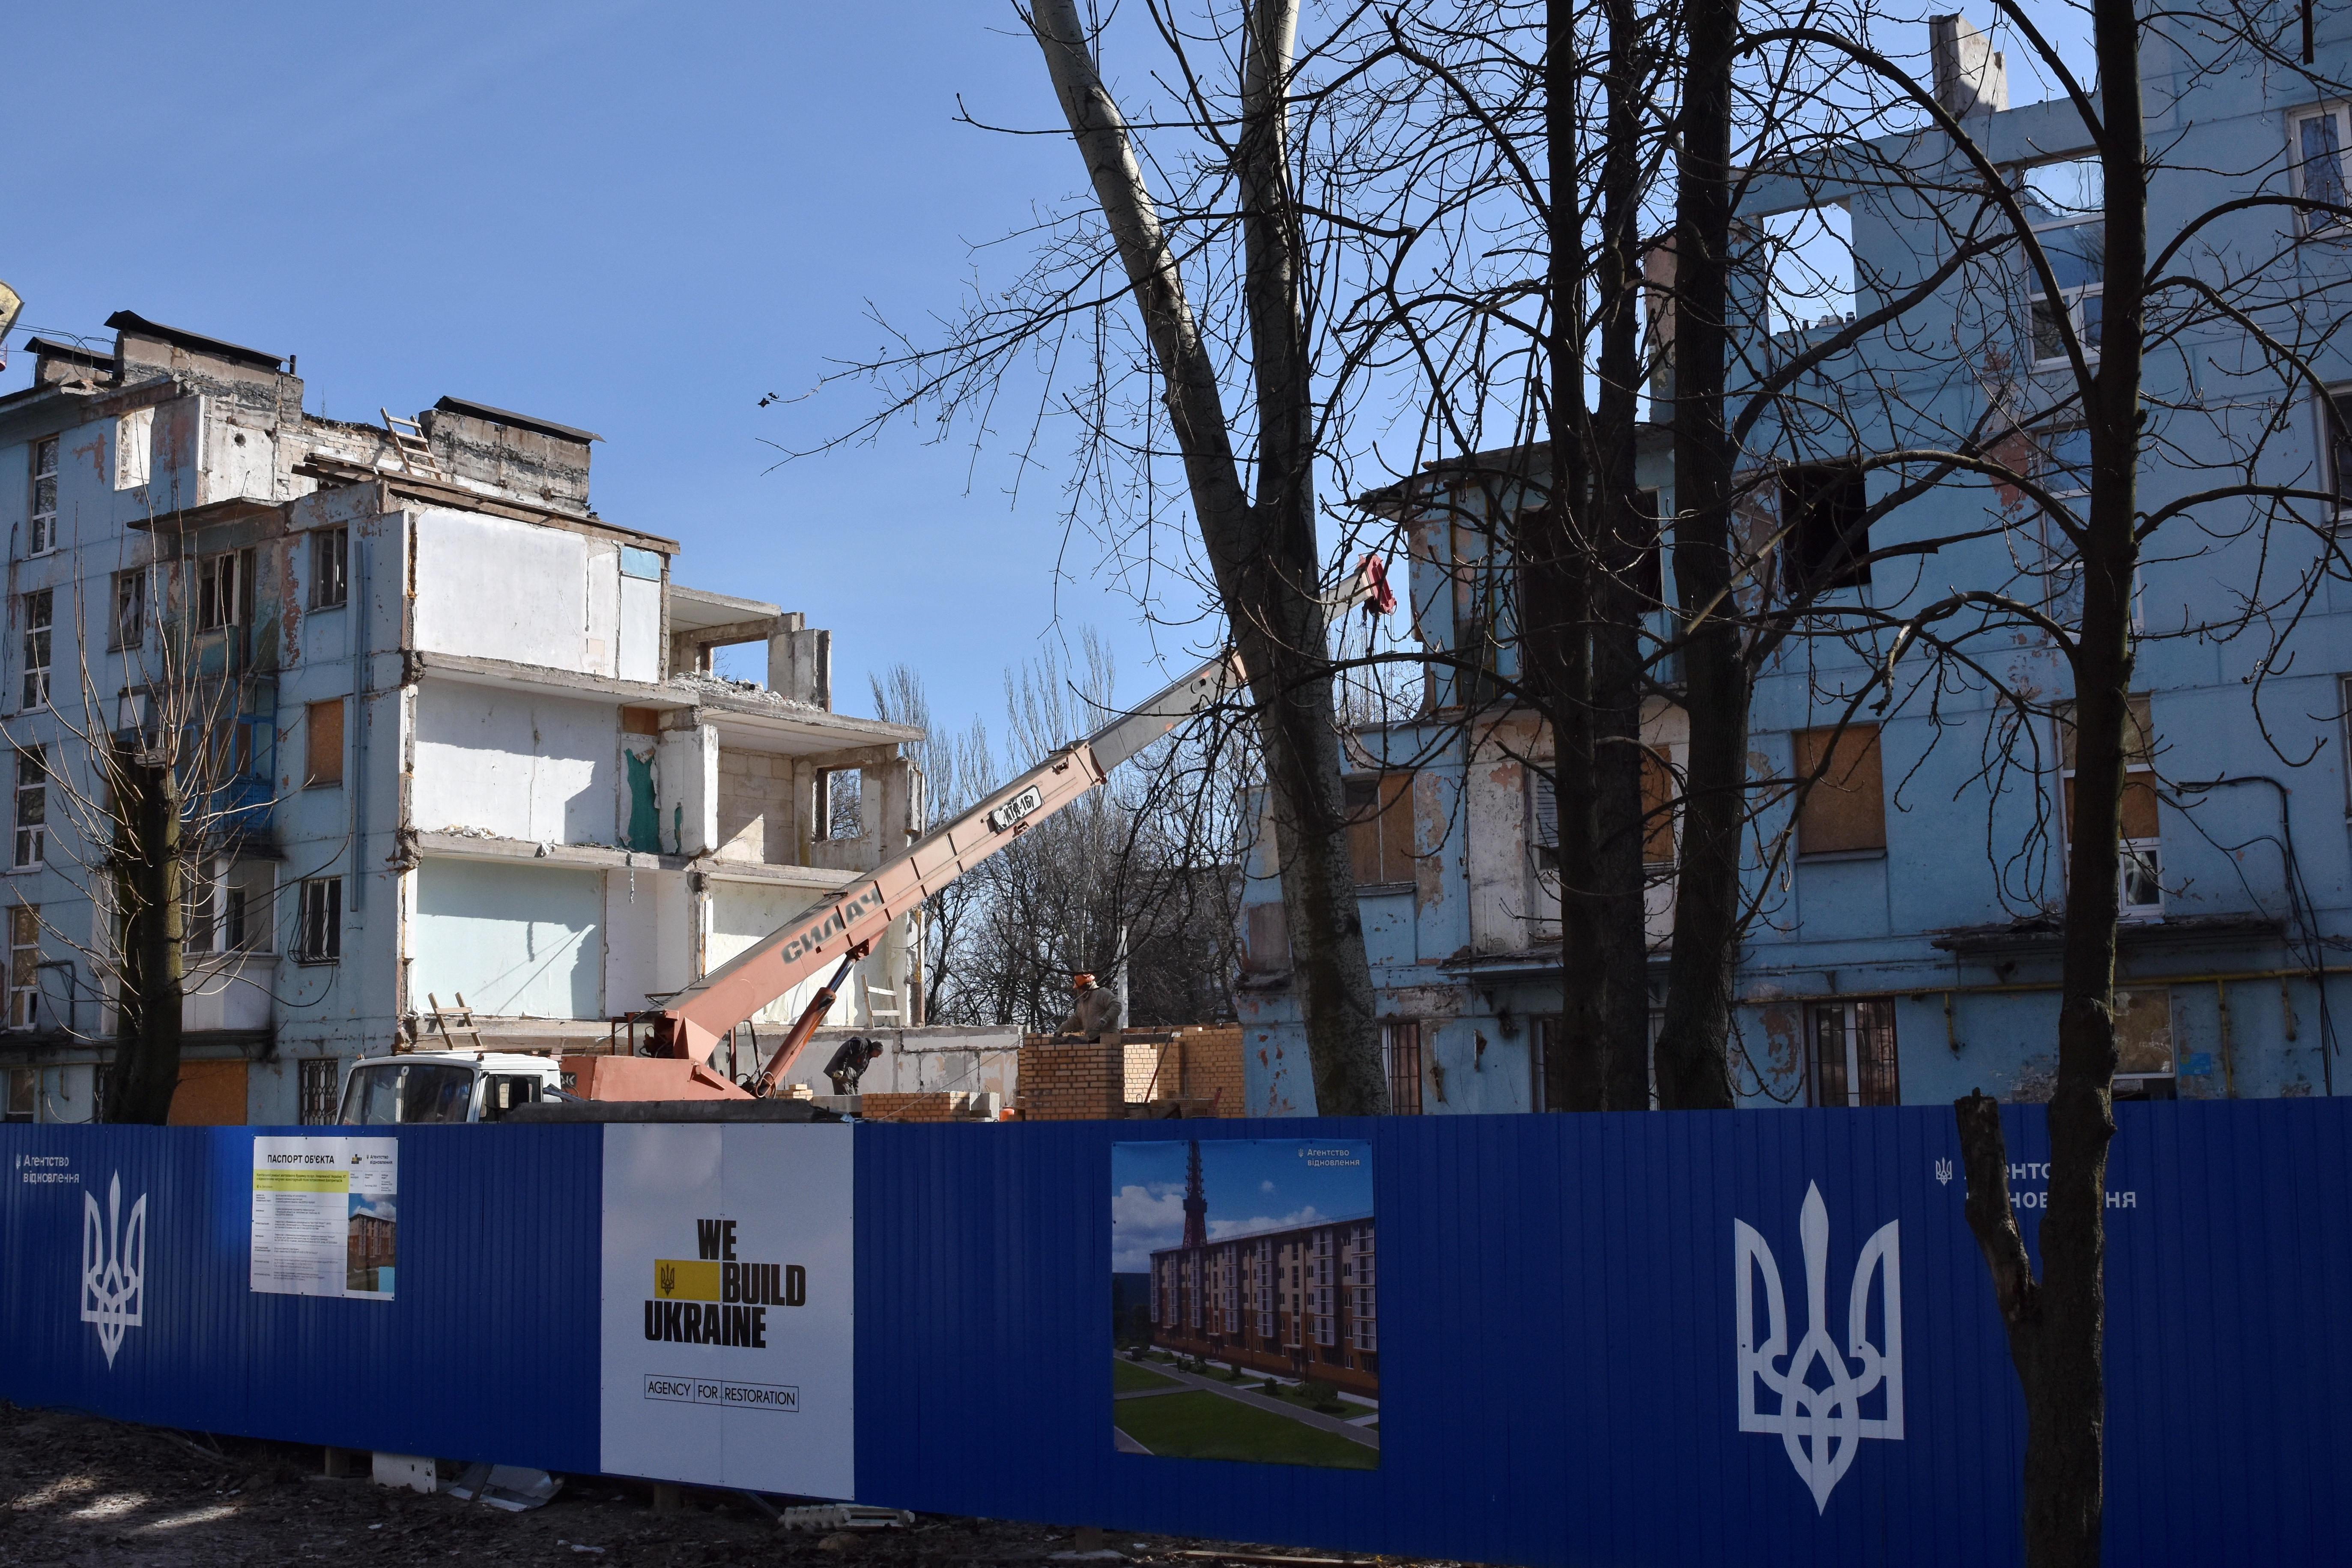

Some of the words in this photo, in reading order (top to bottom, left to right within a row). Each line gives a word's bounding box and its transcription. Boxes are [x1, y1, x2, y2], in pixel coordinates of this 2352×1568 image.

[780, 887, 883, 965] СИЛАЧ
[24, 1155, 69, 1166] Агентство
[267, 1154, 303, 1163] ПАСПОРТ
[1307, 1158, 1360, 1167] відновлення
[24, 1171, 79, 1185] відновлення
[697, 1219, 737, 1261] WE
[722, 1262, 806, 1307] BUILD
[645, 1300, 766, 1348] UKRAINE
[648, 1381, 691, 1396] AGENCY
[698, 1385, 718, 1399] FOR
[725, 1387, 795, 1406] RESTORATION
